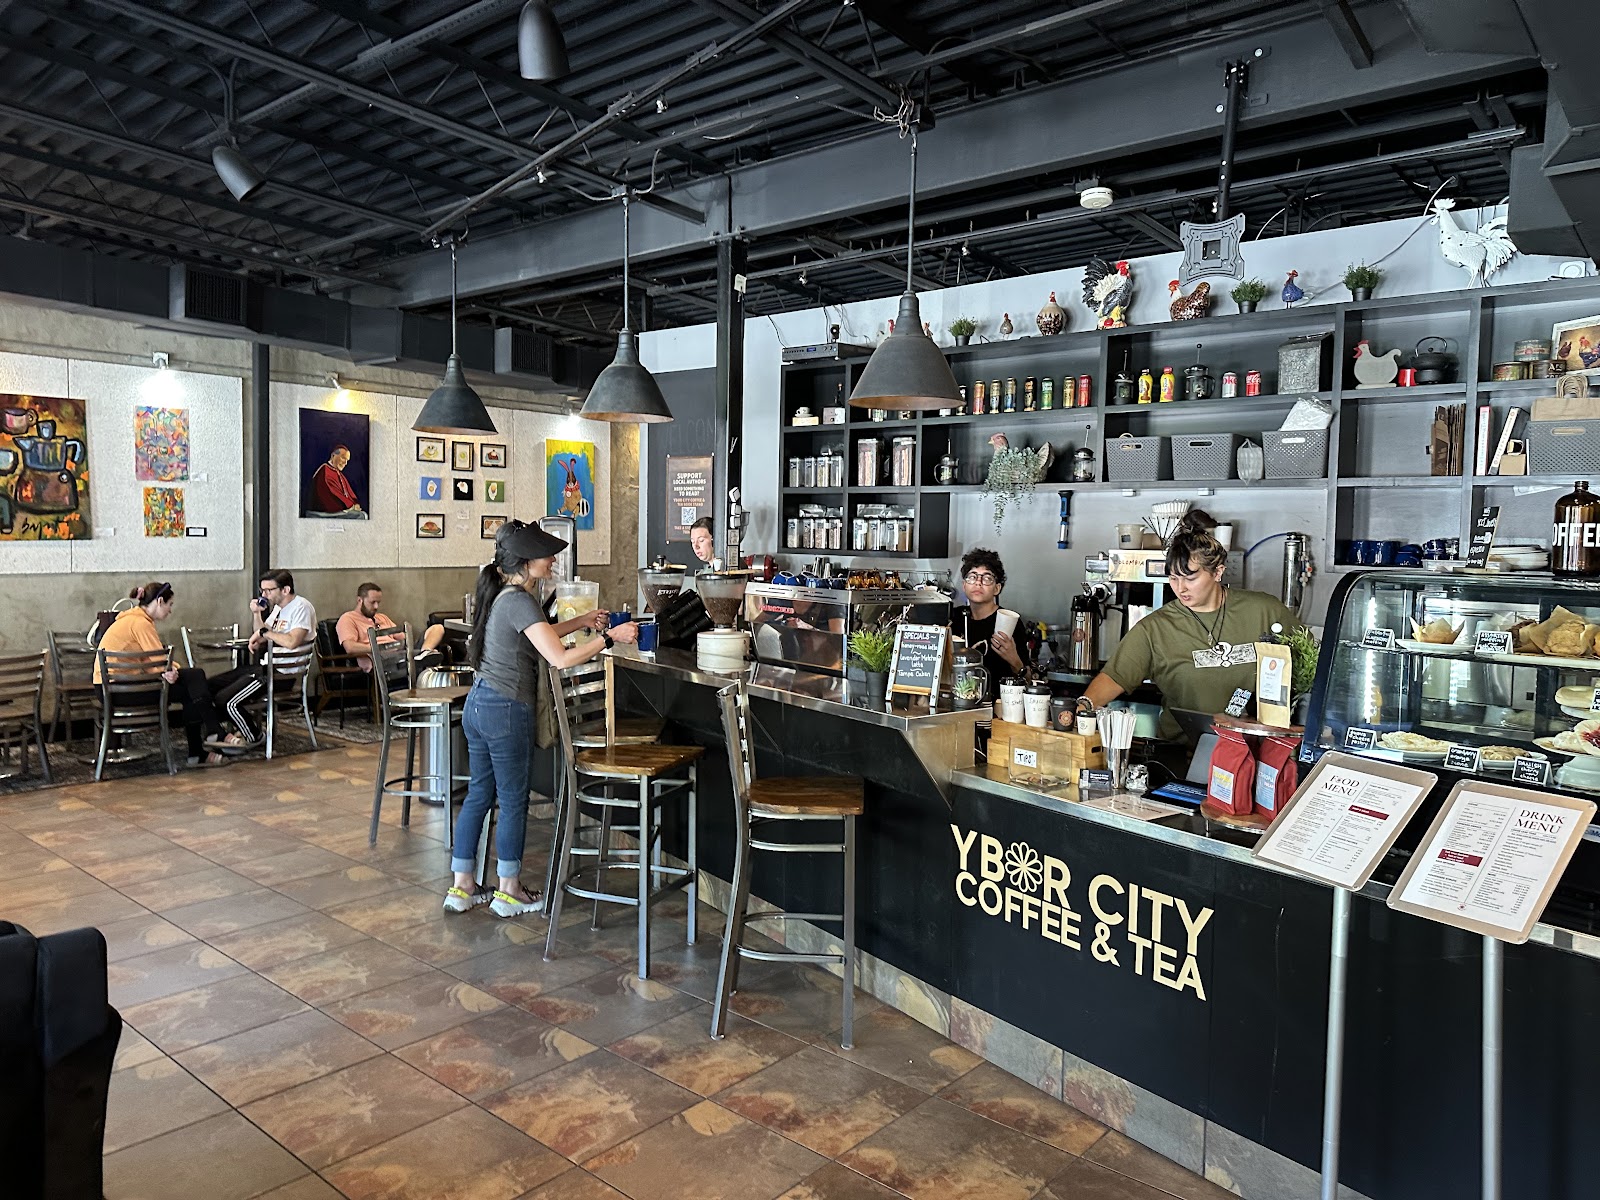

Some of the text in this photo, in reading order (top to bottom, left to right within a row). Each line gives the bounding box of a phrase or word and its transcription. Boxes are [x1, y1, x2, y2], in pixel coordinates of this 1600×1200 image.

[903, 632, 930, 640] SPECIALS
[898, 670, 914, 678] Tampa
[1518, 760, 1542, 769] DANISH
[1321, 782, 1357, 797] MENU
[1520, 809, 1566, 825] DRINK
[1514, 818, 1561, 834] MENU
[1088, 874, 1214, 957] CITY
[955, 871, 1206, 1001] COFFEE & TEA
